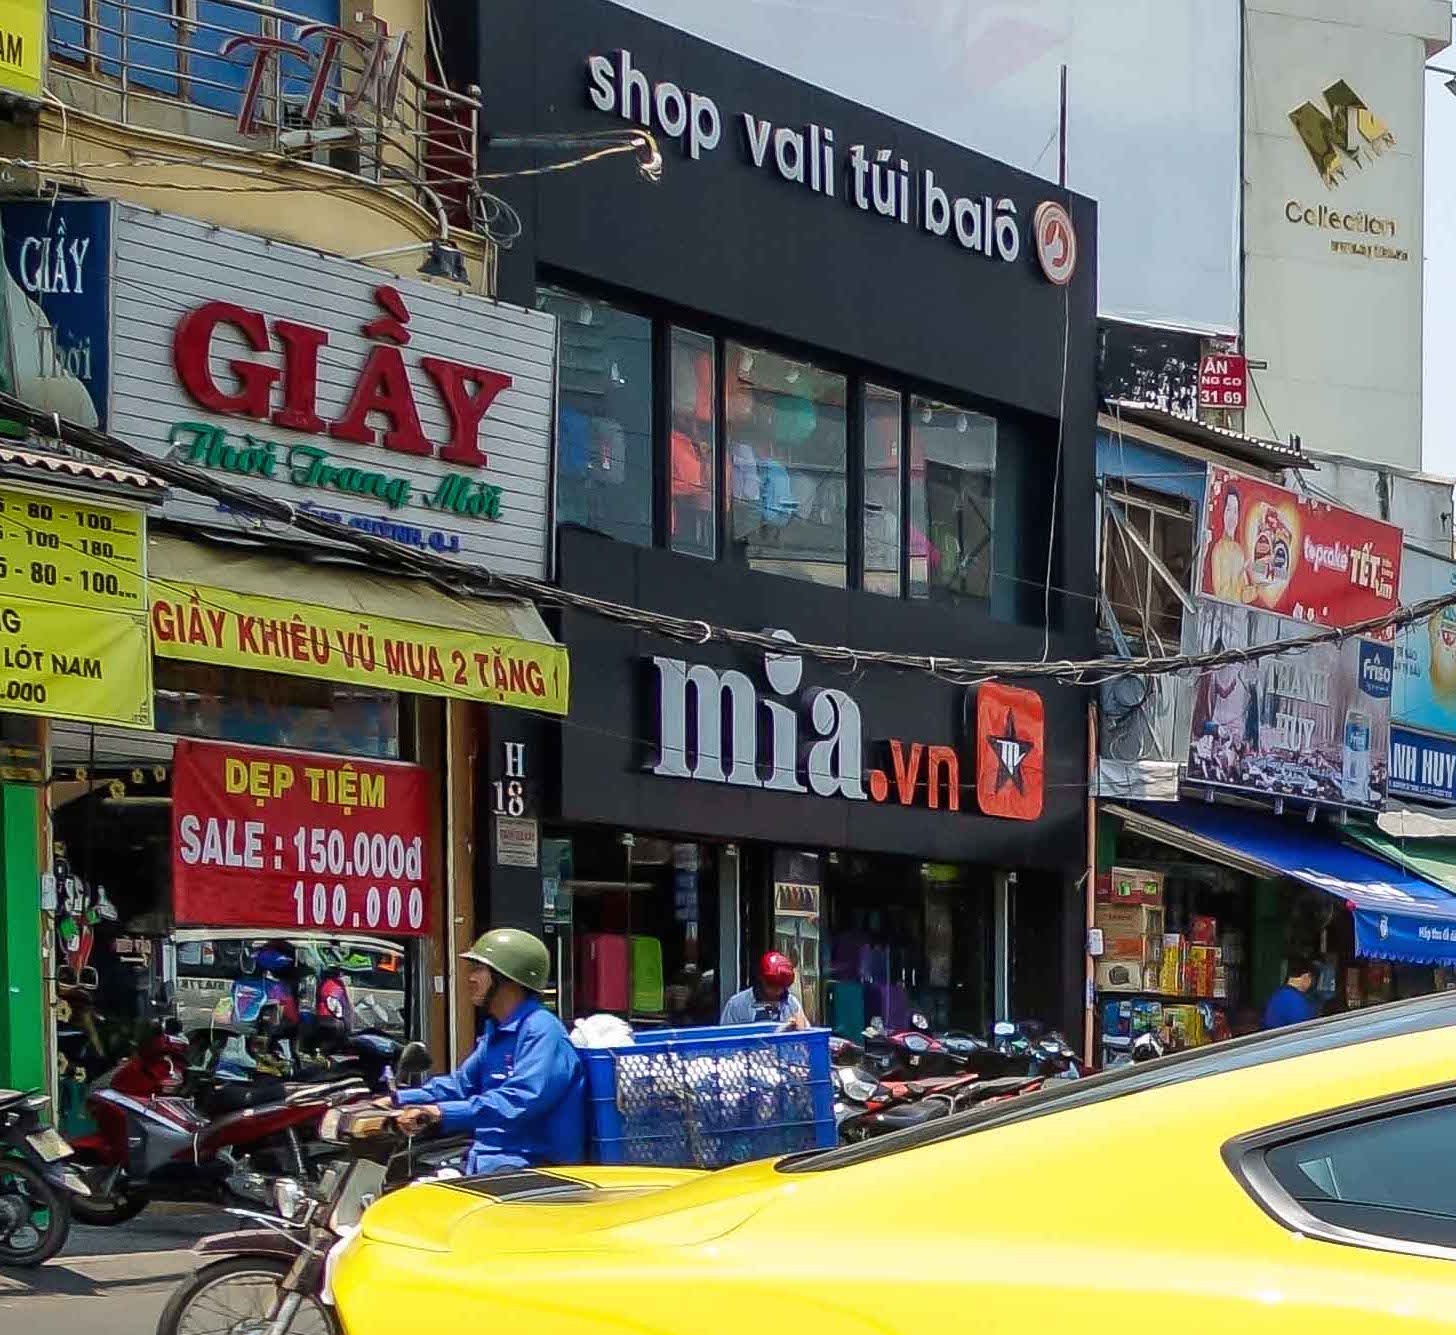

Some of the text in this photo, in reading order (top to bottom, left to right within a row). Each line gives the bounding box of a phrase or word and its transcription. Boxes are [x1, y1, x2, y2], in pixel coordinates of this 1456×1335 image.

[588, 49, 1020, 262] shop vali túi balô
[172, 284, 513, 466] GIẦY
[288, 444, 413, 509] Trang
[30, 561, 57, 586] 80
[52, 653, 103, 680] NAM
[237, 614, 331, 666] KHIÊU
[336, 623, 376, 672] VŨ
[384, 638, 445, 683] MUA
[450, 649, 469, 687] 2
[473, 646, 546, 700] TẶNG
[224, 757, 386, 815] DẸP TIỆM
[504, 741, 526, 778] H
[491, 780, 525, 816] 18
[179, 814, 266, 870] SALE
[293, 825, 423, 880] 150.000đ
[293, 880, 424, 929] 100.000
